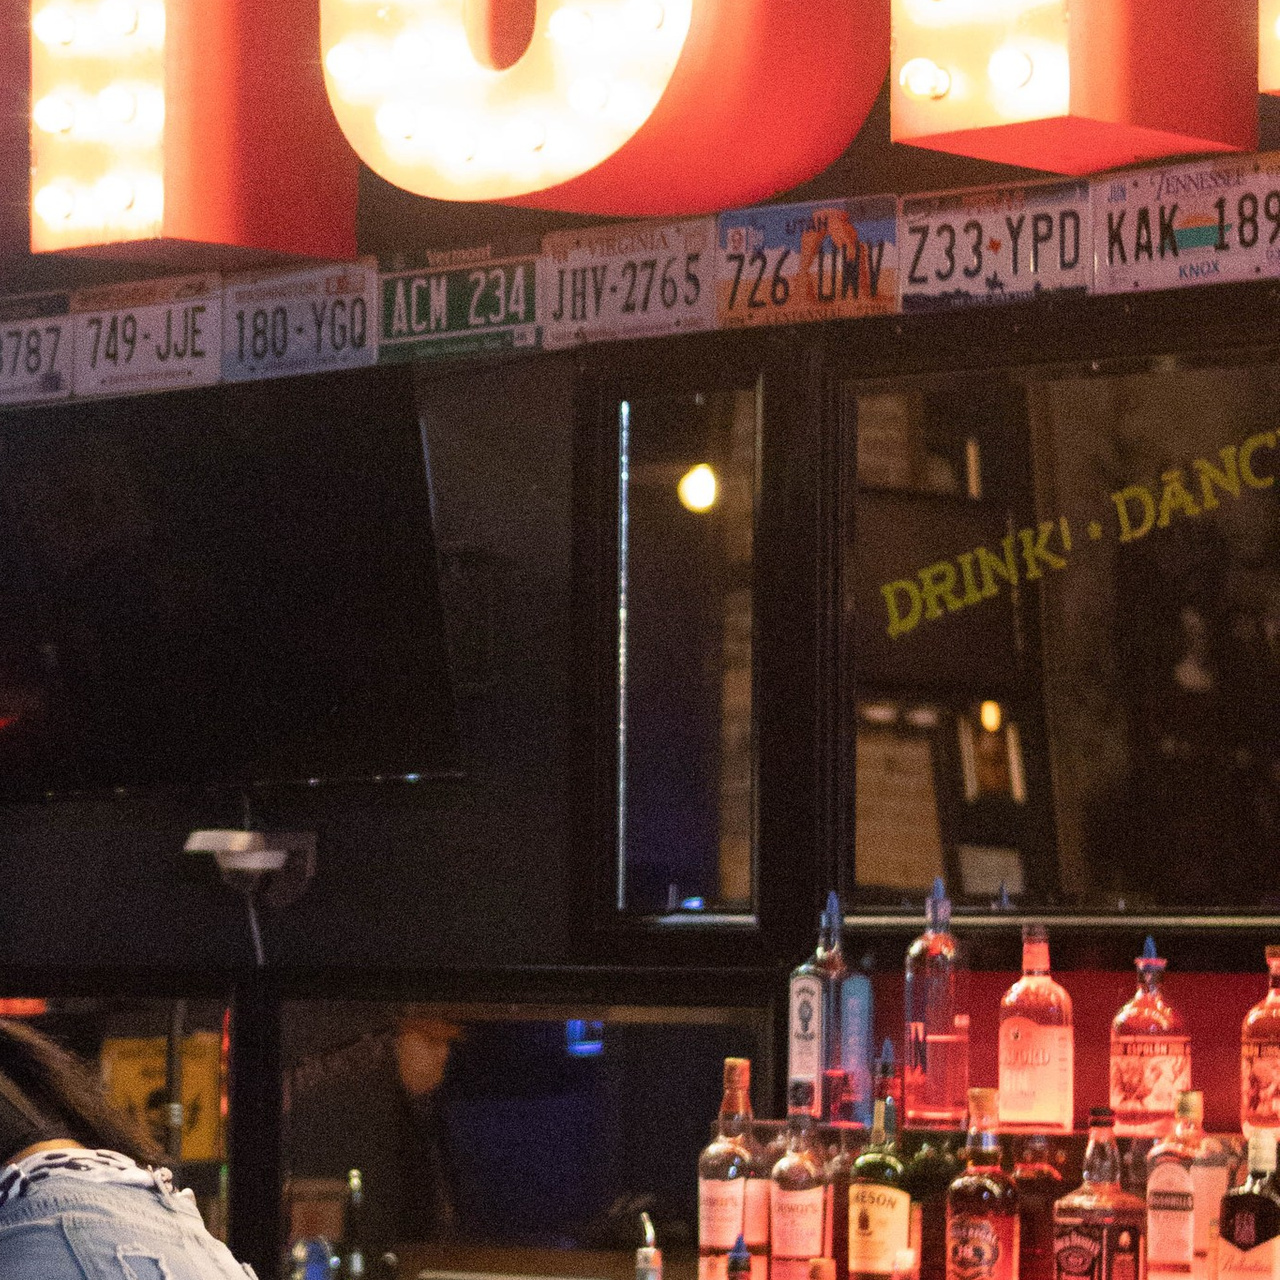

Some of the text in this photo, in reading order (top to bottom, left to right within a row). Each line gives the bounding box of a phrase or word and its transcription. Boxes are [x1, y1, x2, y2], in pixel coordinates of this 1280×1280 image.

[1106, 190, 1280, 265] KAK 189
[390, 265, 527, 335] ACM 234
[726, 249, 791, 311] 726
[1109, 426, 1280, 544] DANC
